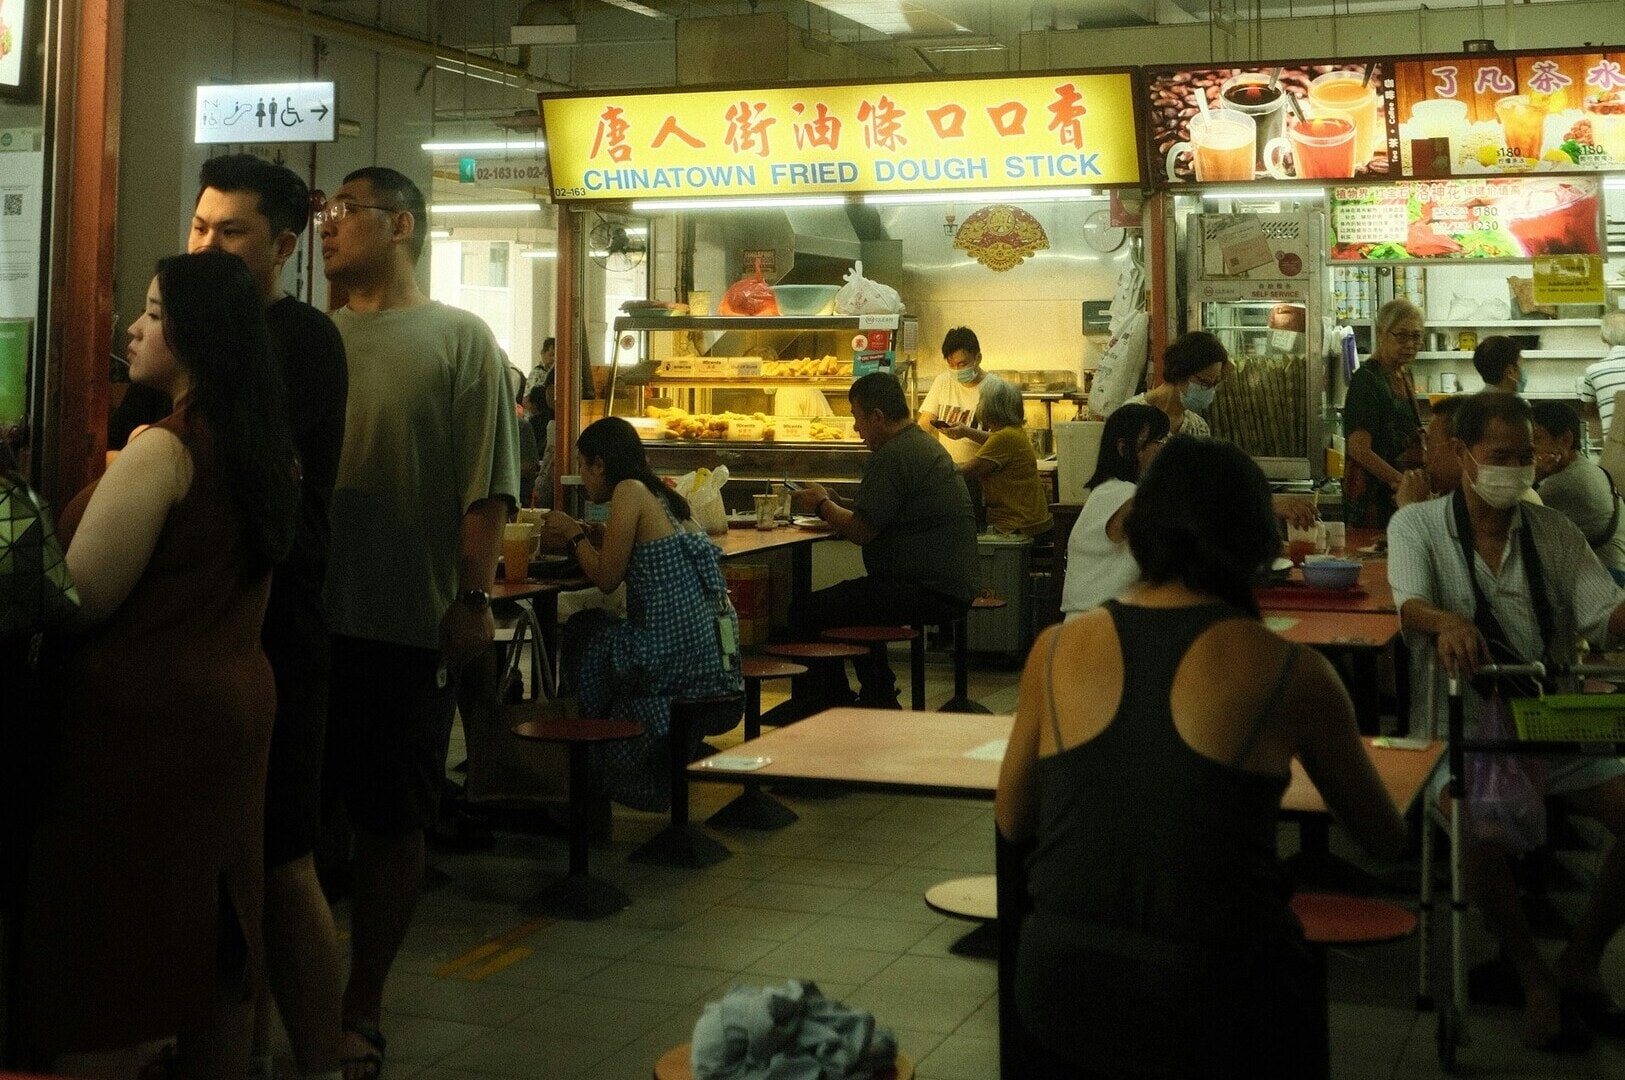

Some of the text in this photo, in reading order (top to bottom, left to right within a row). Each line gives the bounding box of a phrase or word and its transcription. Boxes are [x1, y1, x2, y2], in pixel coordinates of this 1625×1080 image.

[1432, 60, 1625, 97] 了凡茶水
[1388, 102, 1397, 125] Coffee
[589, 84, 1089, 163] 唐人街油條口口香
[1389, 138, 1399, 148] 茶
[1391, 150, 1399, 163] Tea
[1496, 147, 1522, 157] $180
[477, 168, 511, 179] 02-163
[513, 168, 526, 179] to
[583, 152, 1102, 192] CHINATOWN FRIED DOUGH STICK
[554, 186, 586, 198] 02-163
[1336, 188, 1369, 200] 植物界
